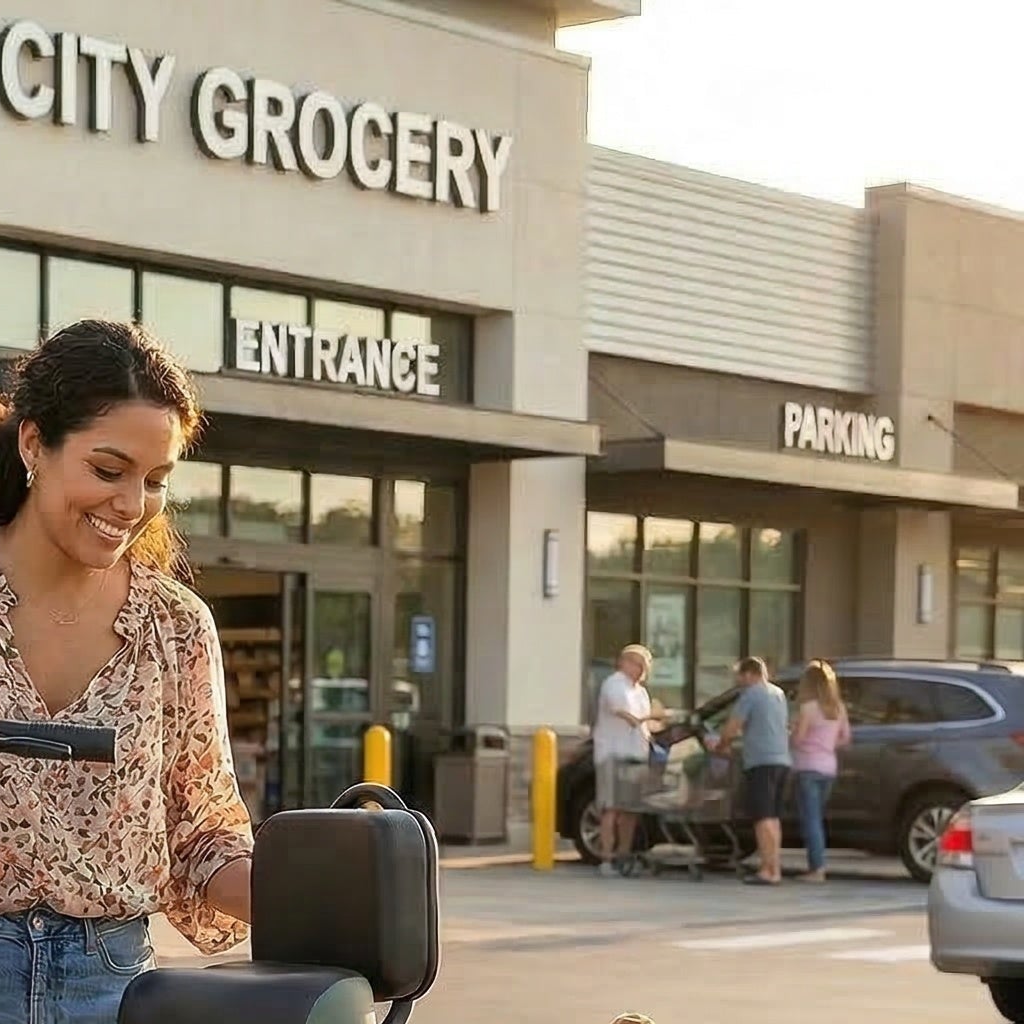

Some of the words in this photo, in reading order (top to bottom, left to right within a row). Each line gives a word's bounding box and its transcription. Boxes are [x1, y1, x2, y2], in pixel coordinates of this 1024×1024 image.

[191, 66, 514, 212] GROCERY
[235, 318, 441, 396] ENTRANCE
[783, 401, 896, 461] PARKING
